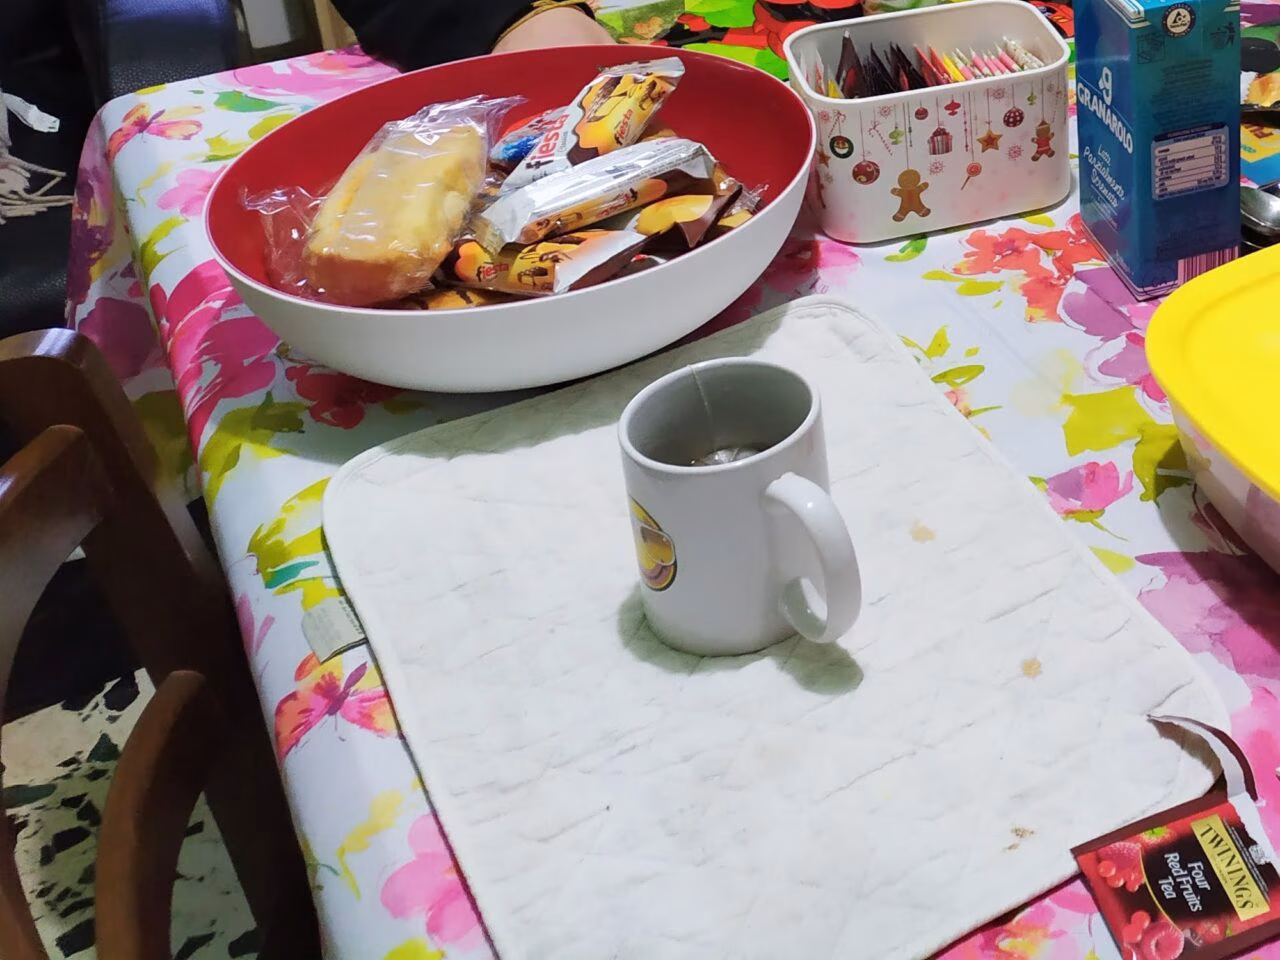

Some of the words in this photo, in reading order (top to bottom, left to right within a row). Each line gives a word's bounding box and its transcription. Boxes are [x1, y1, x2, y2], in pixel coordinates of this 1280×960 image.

[614, 108, 634, 146] fiesta
[1077, 82, 1133, 155] GRANAROLO
[525, 113, 570, 170] fiesta
[1164, 852, 1187, 877] Red
[1187, 861, 1211, 891] Four
[1199, 823, 1254, 910] TWININGS
[1158, 876, 1177, 899] Tea
[1175, 870, 1203, 912] Fruits
